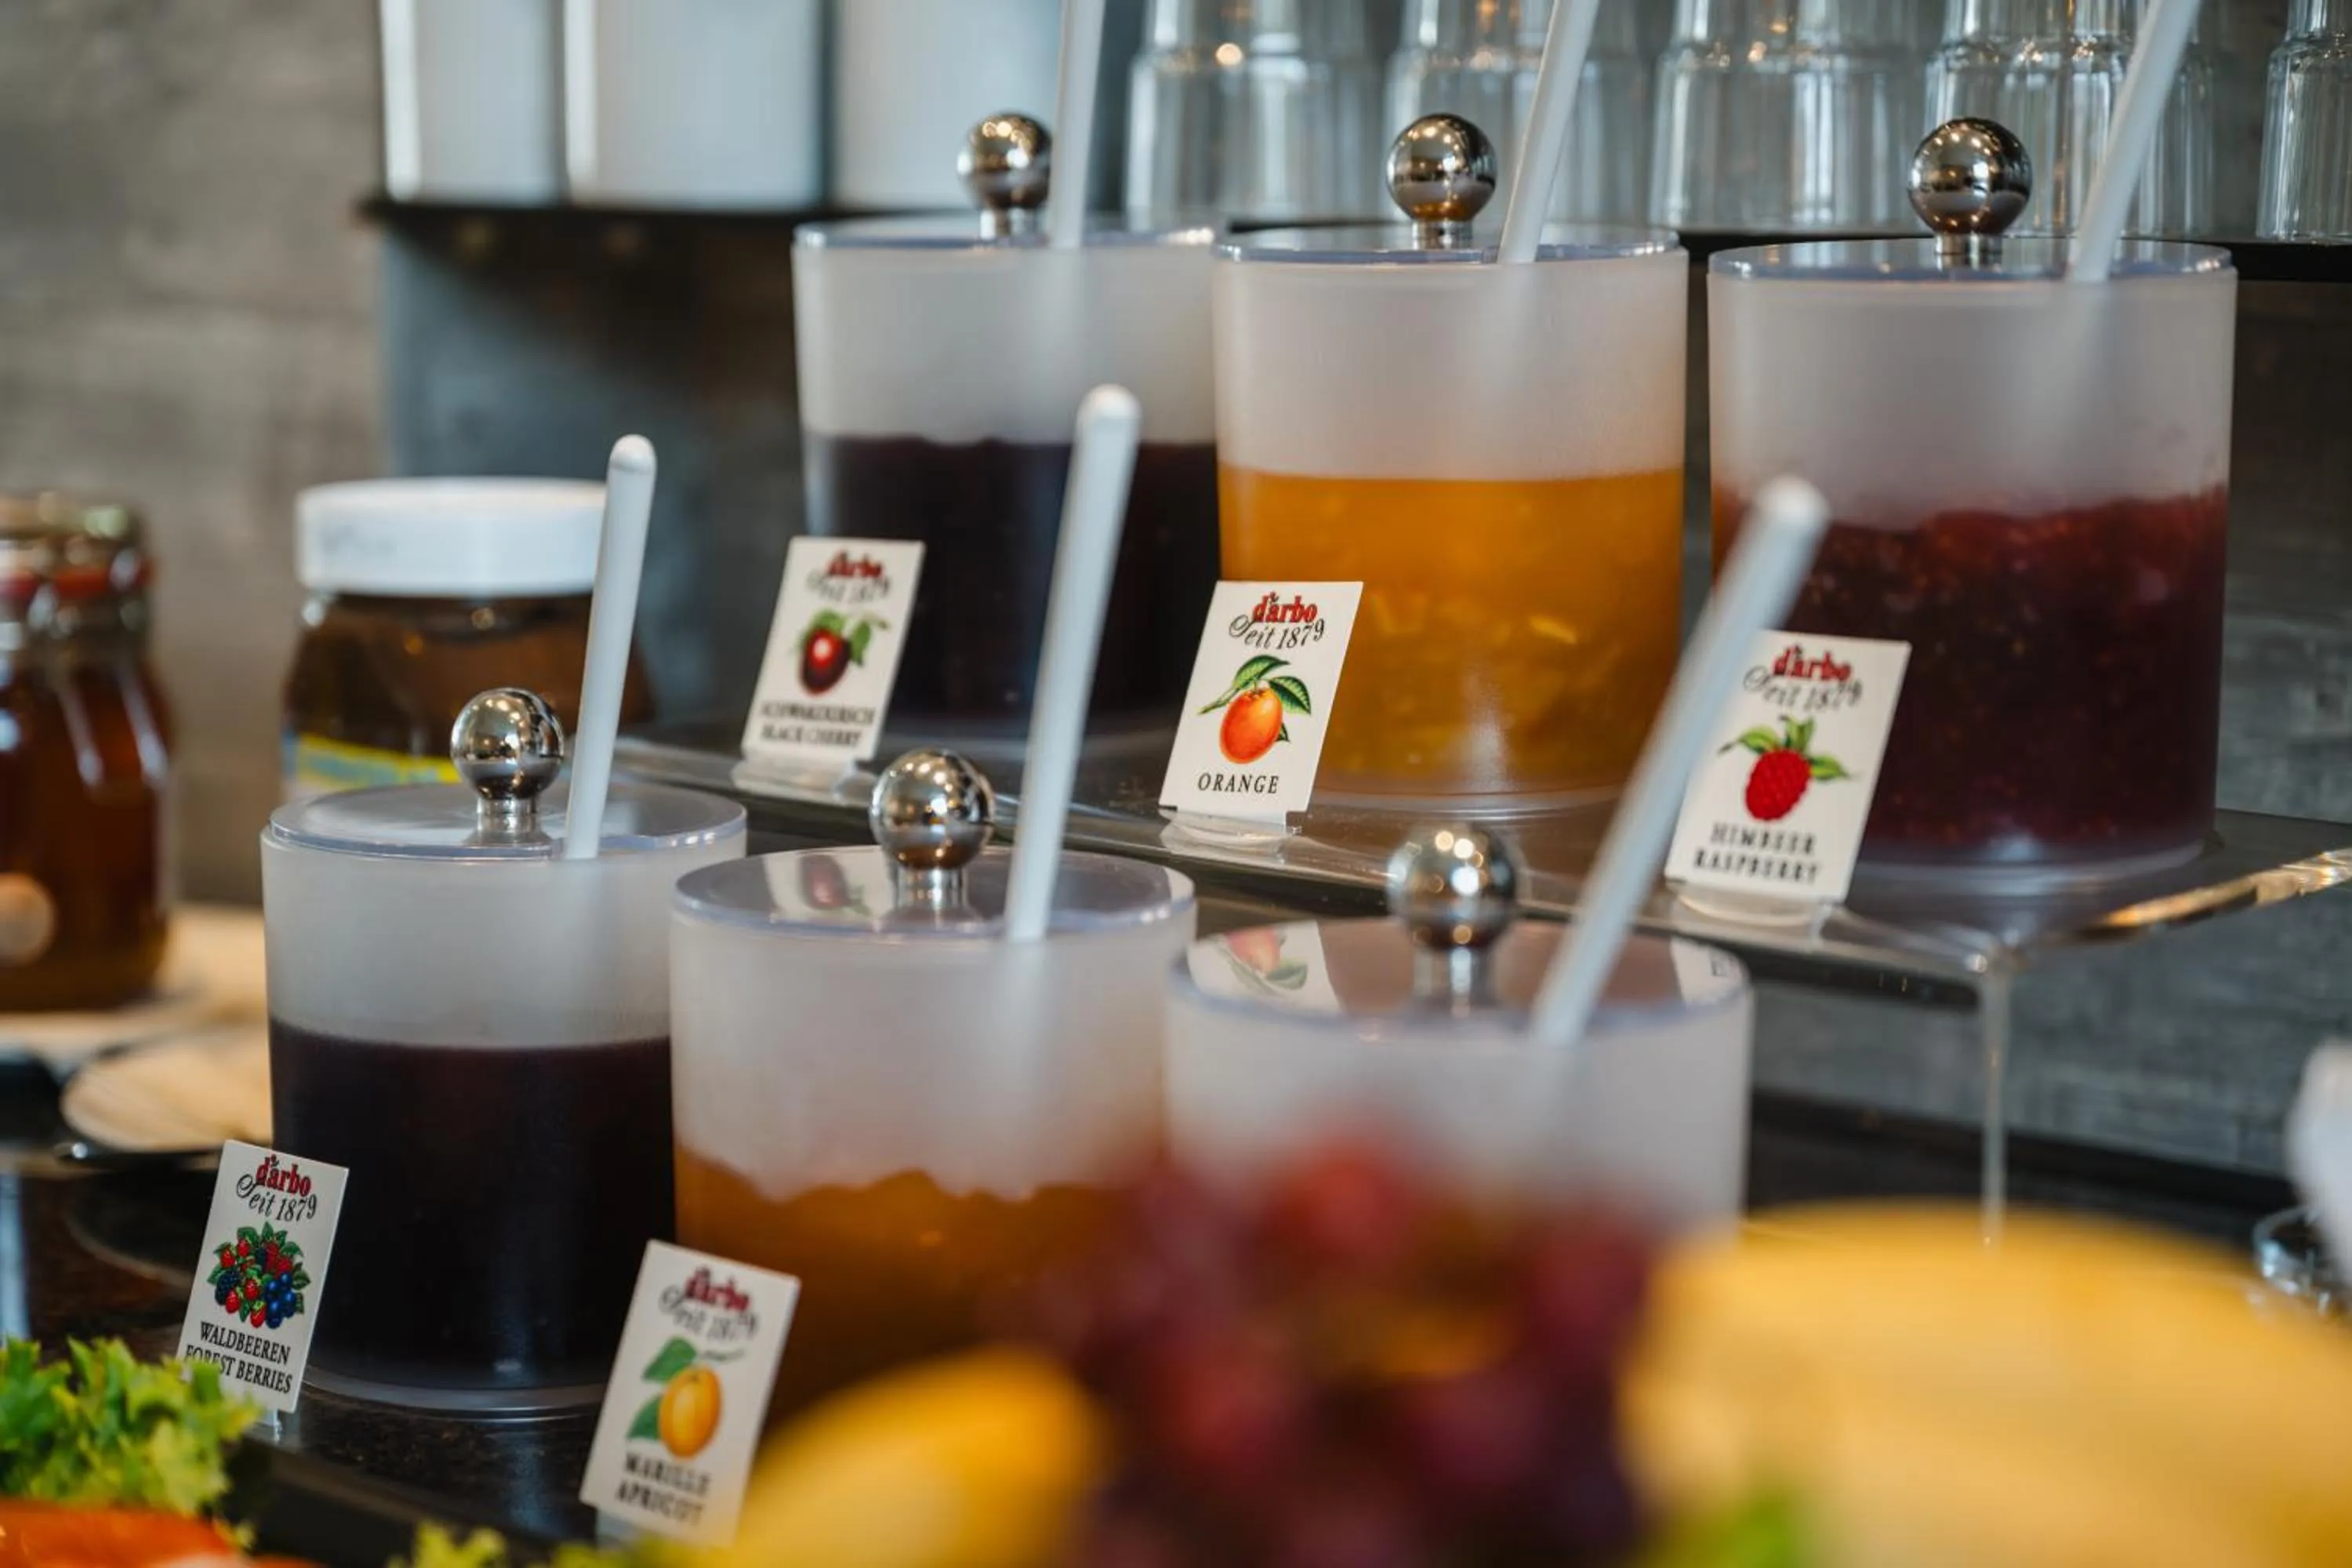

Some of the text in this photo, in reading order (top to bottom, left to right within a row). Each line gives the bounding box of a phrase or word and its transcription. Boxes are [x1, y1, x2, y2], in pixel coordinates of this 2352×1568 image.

[1229, 614, 1324, 650] Seit 1879
[1197, 772, 1279, 793] ORANGE
[236, 1174, 317, 1222] Seit 1879
[200, 1320, 291, 1366] WALDBEEREN
[236, 1359, 293, 1394] BERRIES
